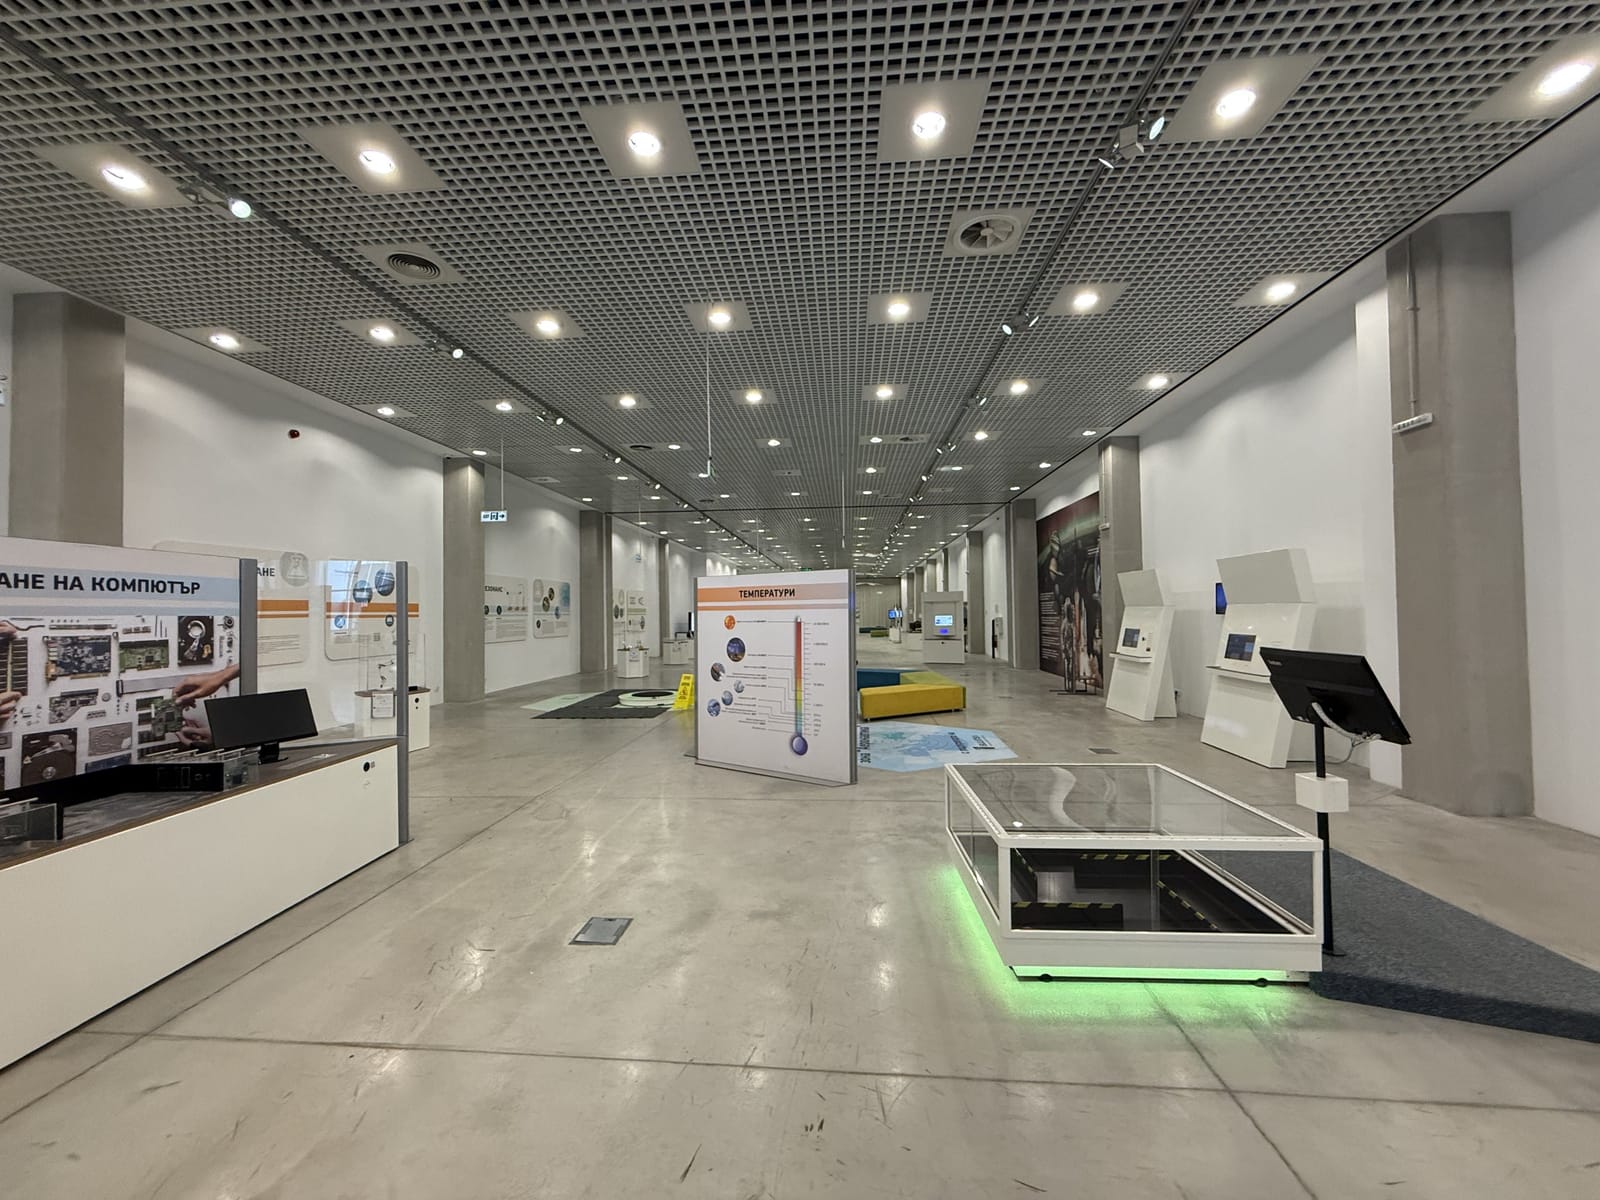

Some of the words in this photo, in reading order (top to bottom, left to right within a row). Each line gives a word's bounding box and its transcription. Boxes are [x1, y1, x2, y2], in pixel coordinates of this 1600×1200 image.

[0, 572, 45, 589] АНЕ
[53, 575, 84, 591] НА
[91, 577, 200, 594] КОМПЮТЪР
[739, 588, 796, 599] ТЕМПЕРАТУРИ
